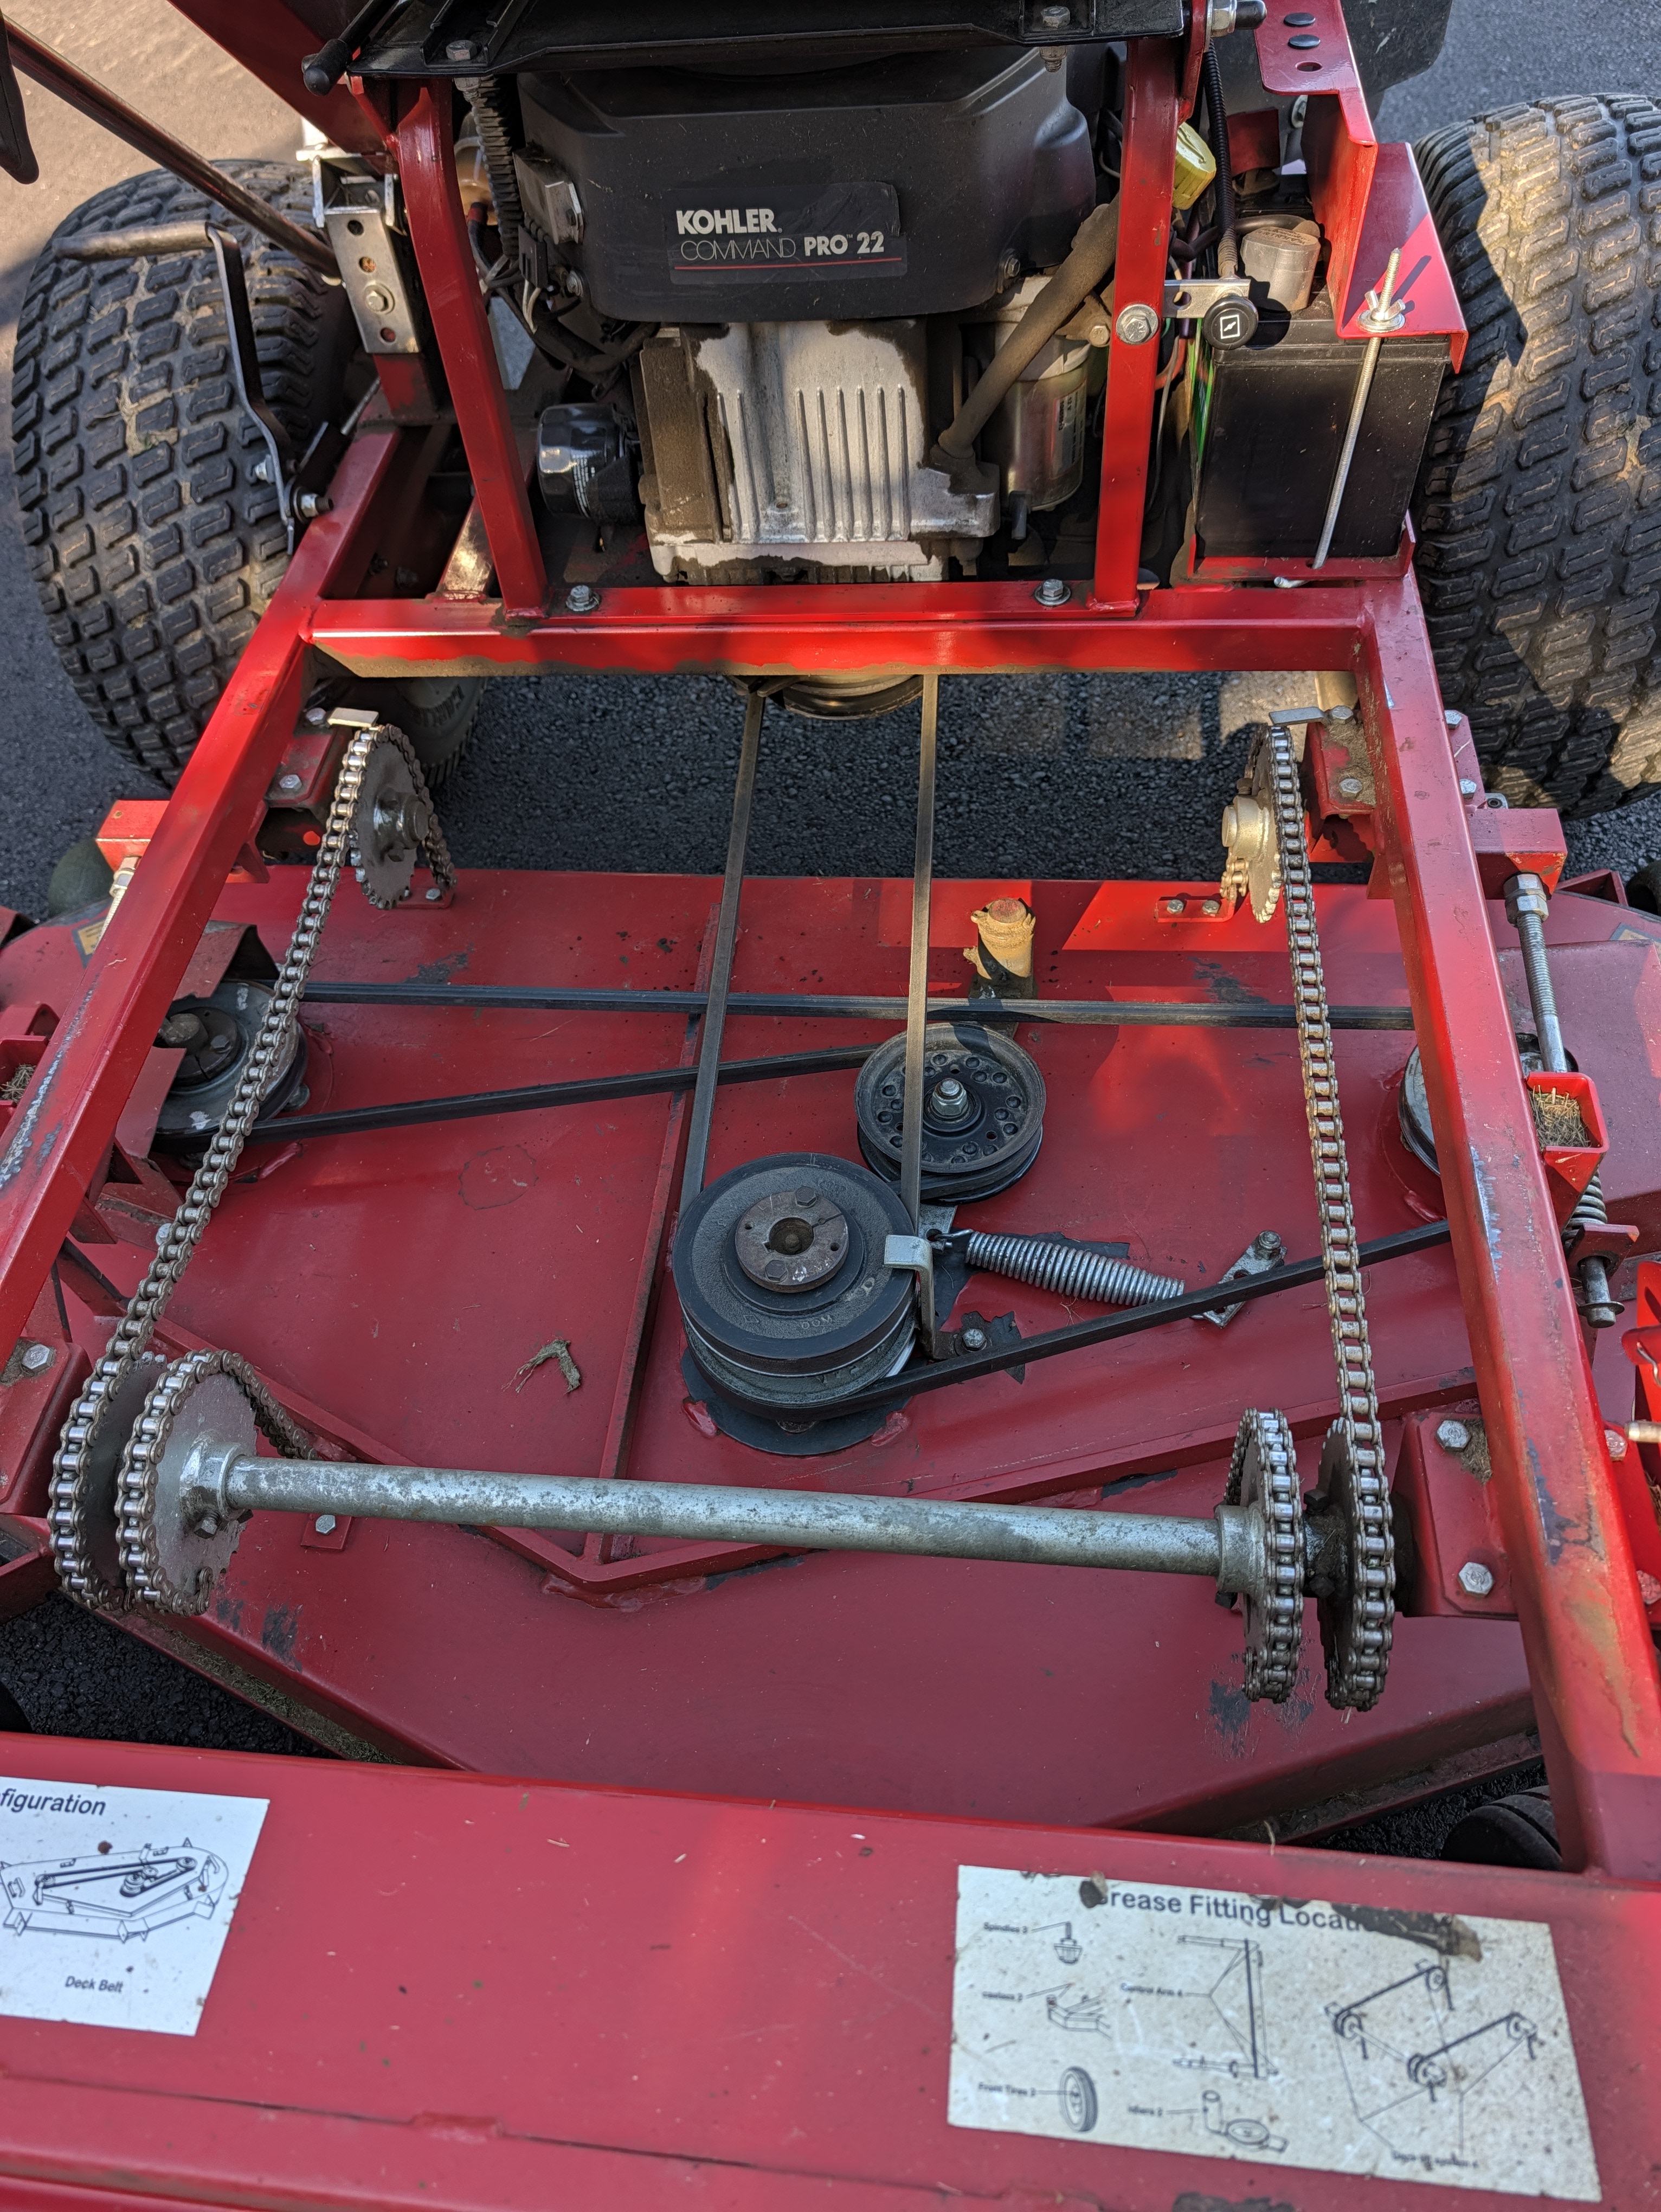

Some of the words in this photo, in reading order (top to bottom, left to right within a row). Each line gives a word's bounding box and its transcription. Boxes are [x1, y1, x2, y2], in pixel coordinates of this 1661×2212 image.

[676, 208, 776, 235] KOHLER
[680, 237, 796, 261] COMMAND
[857, 231, 885, 254] 22
[0, 1787, 106, 1816] figuration
[1099, 1891, 1182, 1913] rease
[1189, 1893, 1271, 1927] Fitting
[65, 1975, 96, 1990] Deck
[98, 1978, 124, 1993] Belt
